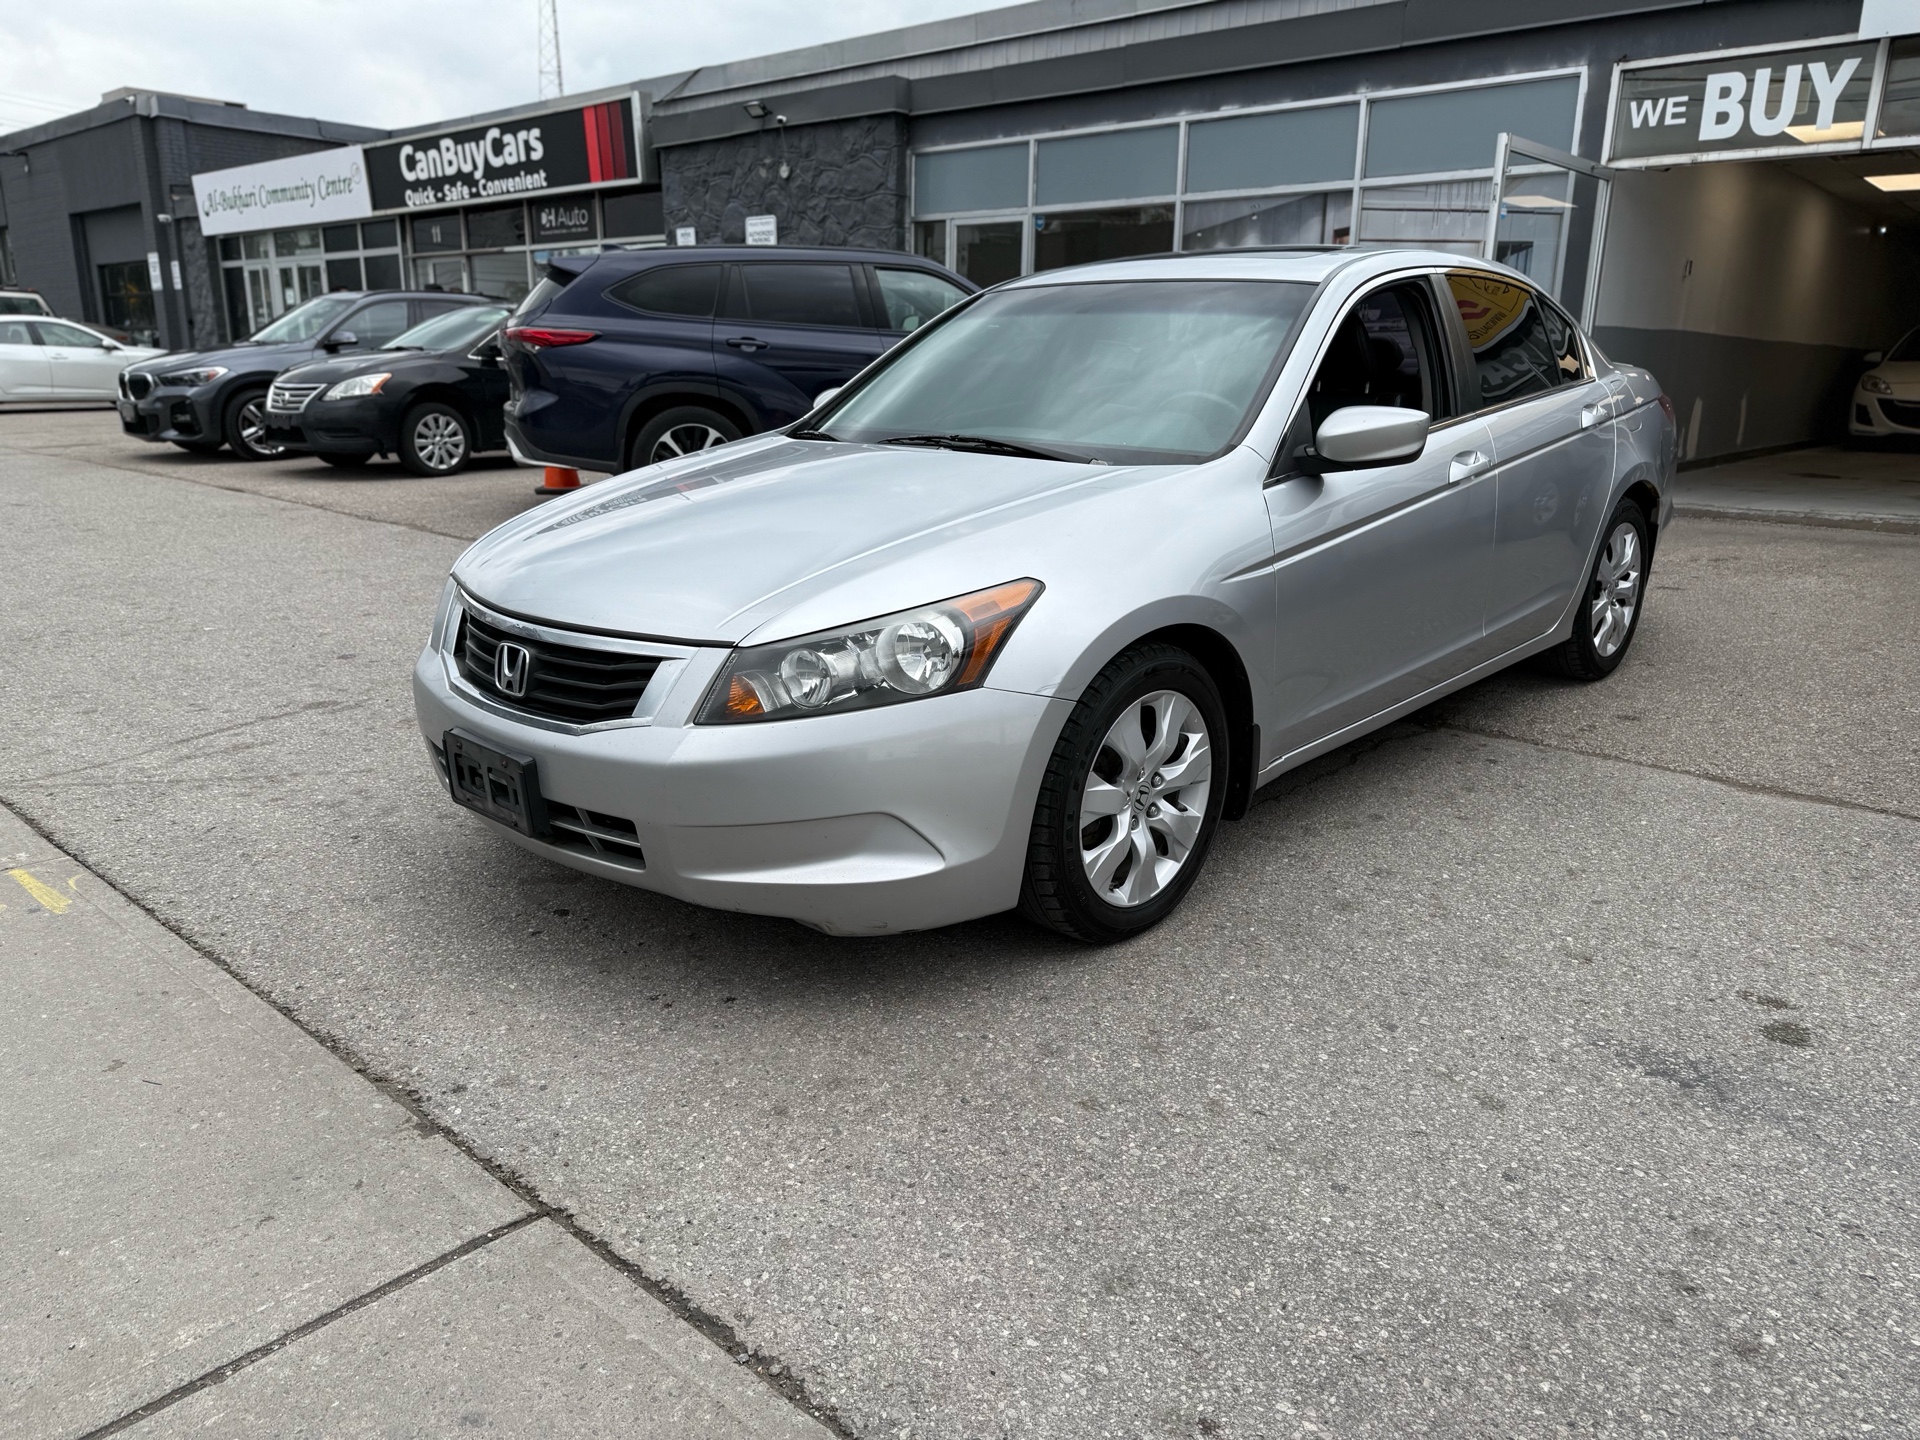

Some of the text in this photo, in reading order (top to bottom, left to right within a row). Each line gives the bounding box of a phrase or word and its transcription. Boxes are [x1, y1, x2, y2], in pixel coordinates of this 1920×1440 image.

[1630, 57, 1863, 142] WE BUY
[399, 127, 544, 182] CanBuyCars
[202, 174, 353, 217] Al-Bukhari Community Centre
[405, 169, 548, 207] Quick Safe Convenient
[431, 224, 442, 243] 11
[557, 206, 589, 227] Auto
